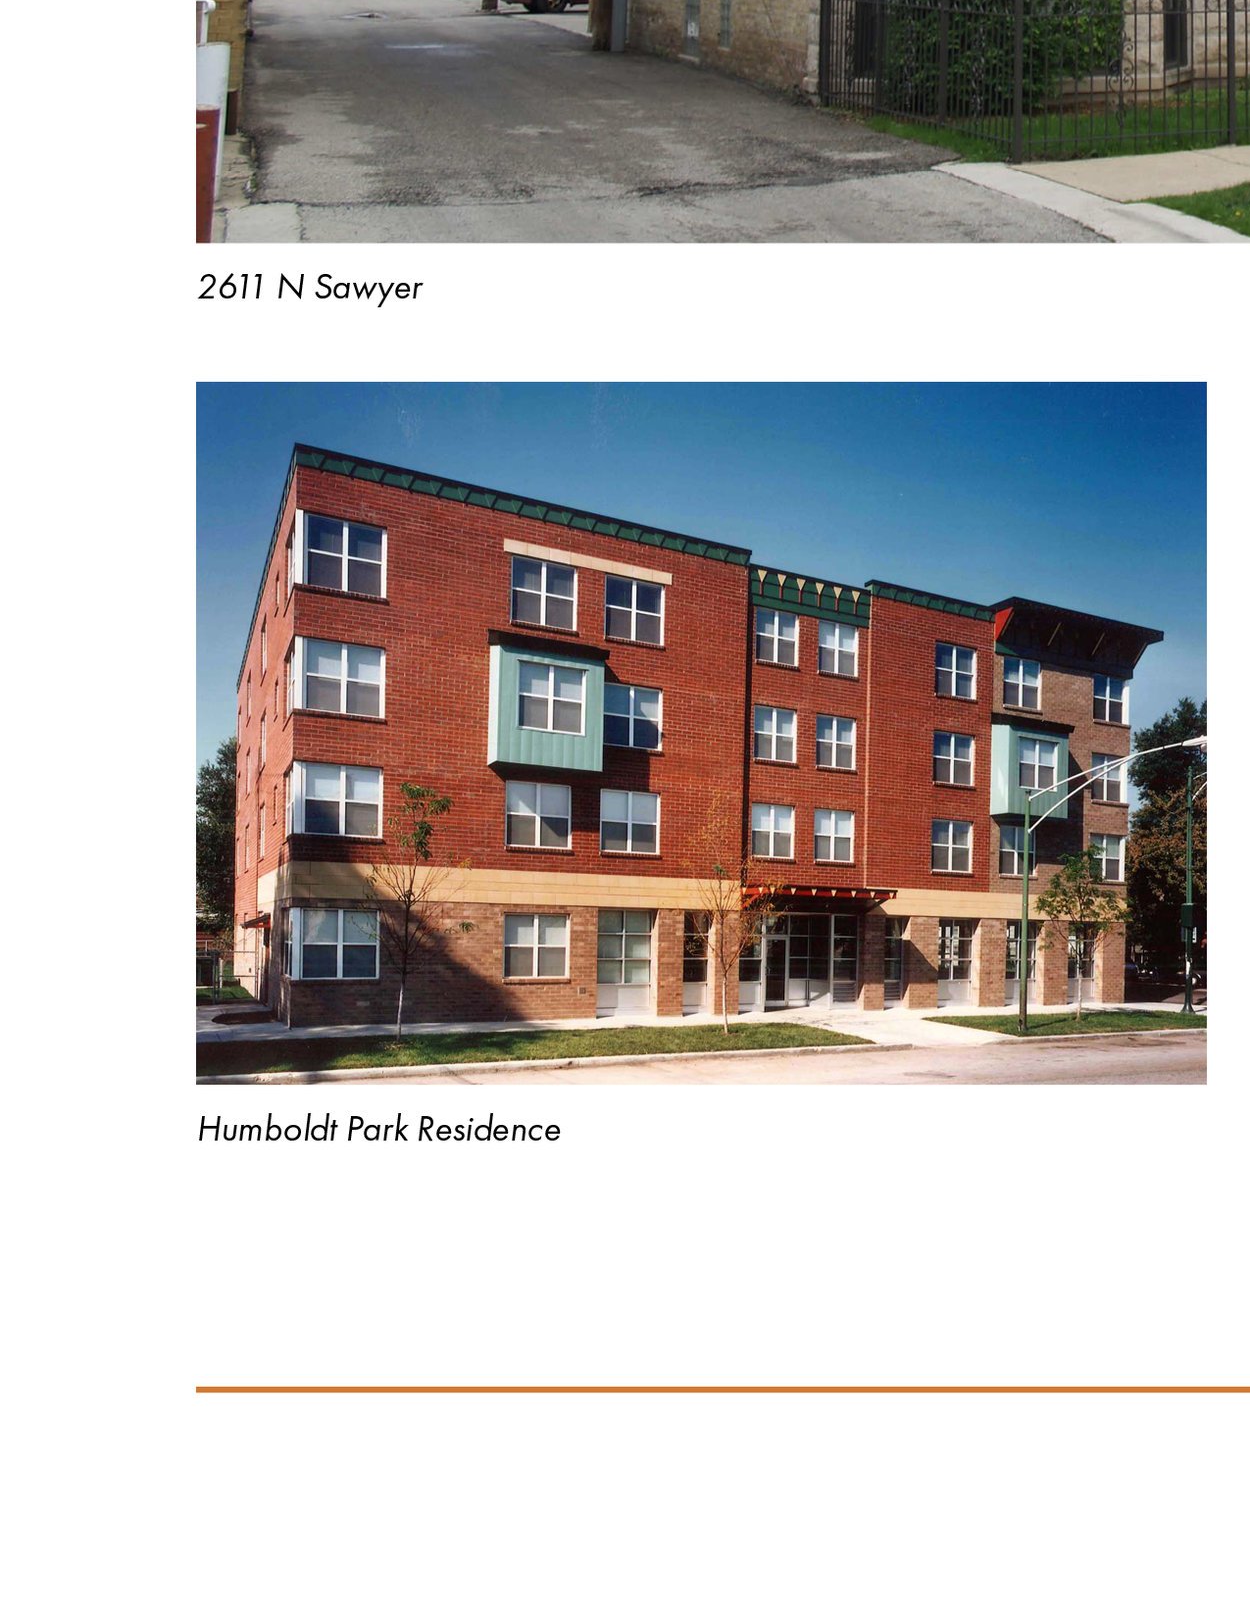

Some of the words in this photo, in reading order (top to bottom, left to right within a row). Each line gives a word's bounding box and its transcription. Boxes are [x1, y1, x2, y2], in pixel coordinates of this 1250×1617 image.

[197, 272, 263, 300] 2611
[277, 272, 305, 300] N
[314, 273, 425, 309] Sawyer
[198, 1112, 339, 1142] Humboldt
[347, 1112, 410, 1142] Park
[417, 1112, 561, 1142] Residence
